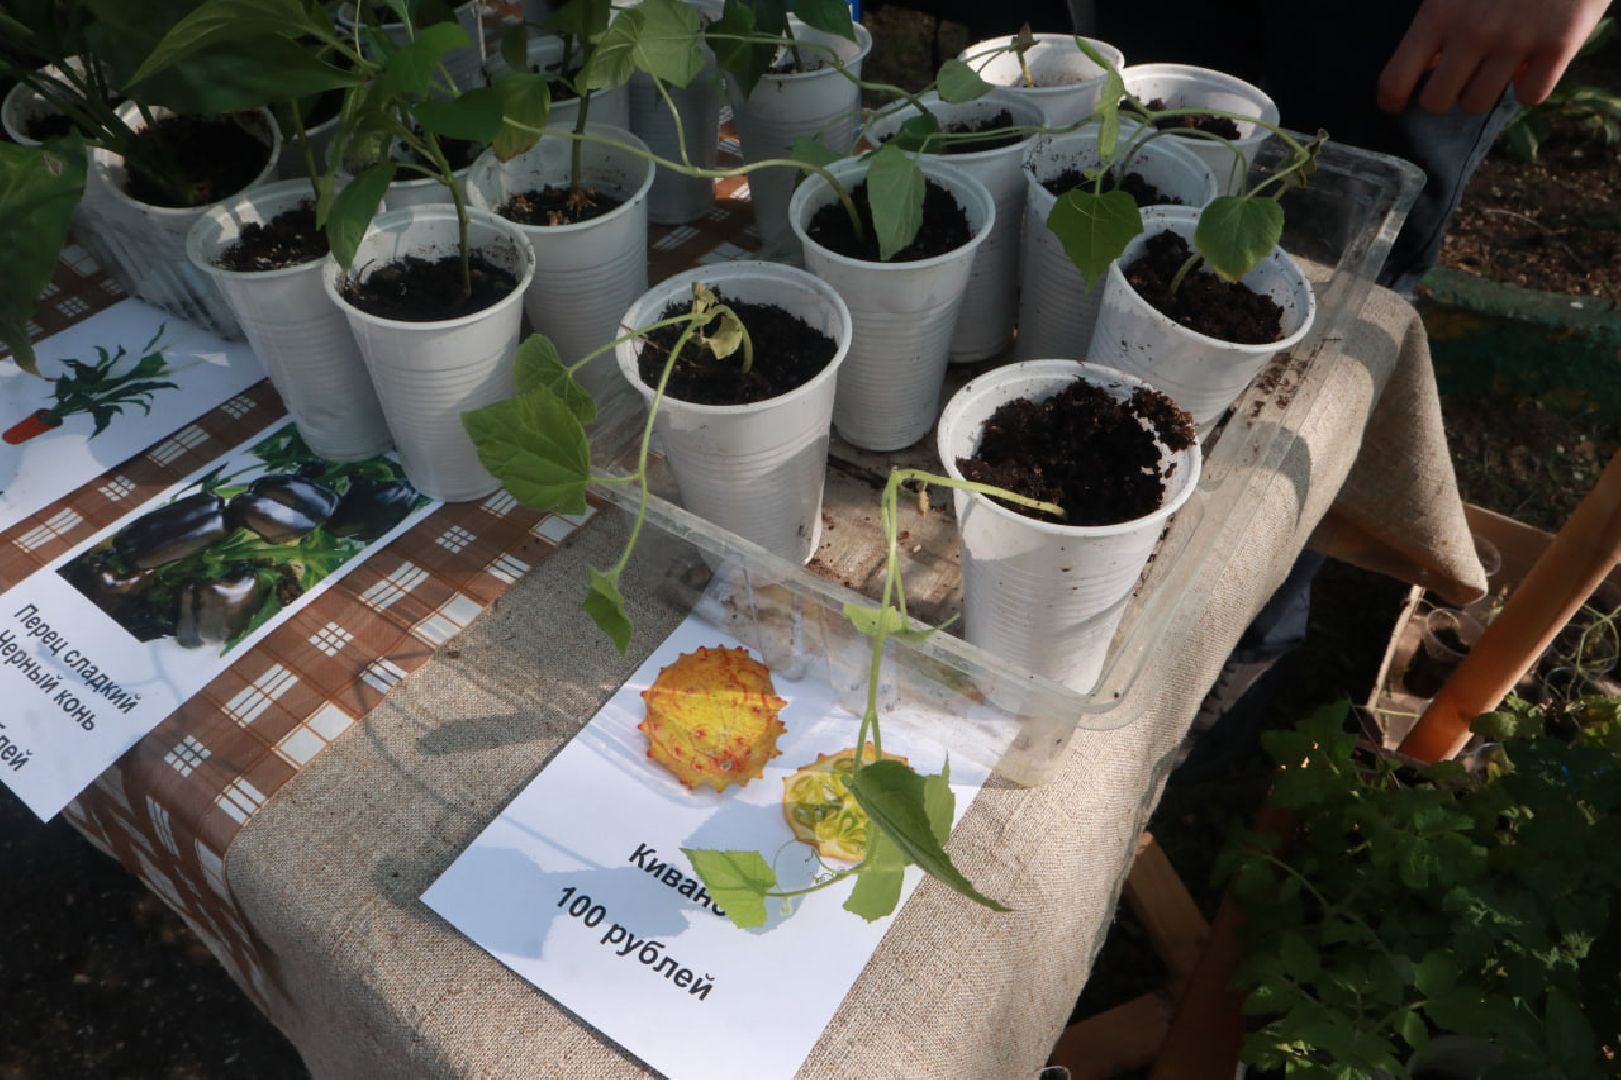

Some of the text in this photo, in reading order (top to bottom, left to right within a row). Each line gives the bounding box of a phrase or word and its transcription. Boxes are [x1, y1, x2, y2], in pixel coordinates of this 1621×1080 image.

[0, 629, 96, 731] Черный конь
[14, 602, 141, 714] Перец сладкий
[557, 886, 715, 1001] 100 рублей
